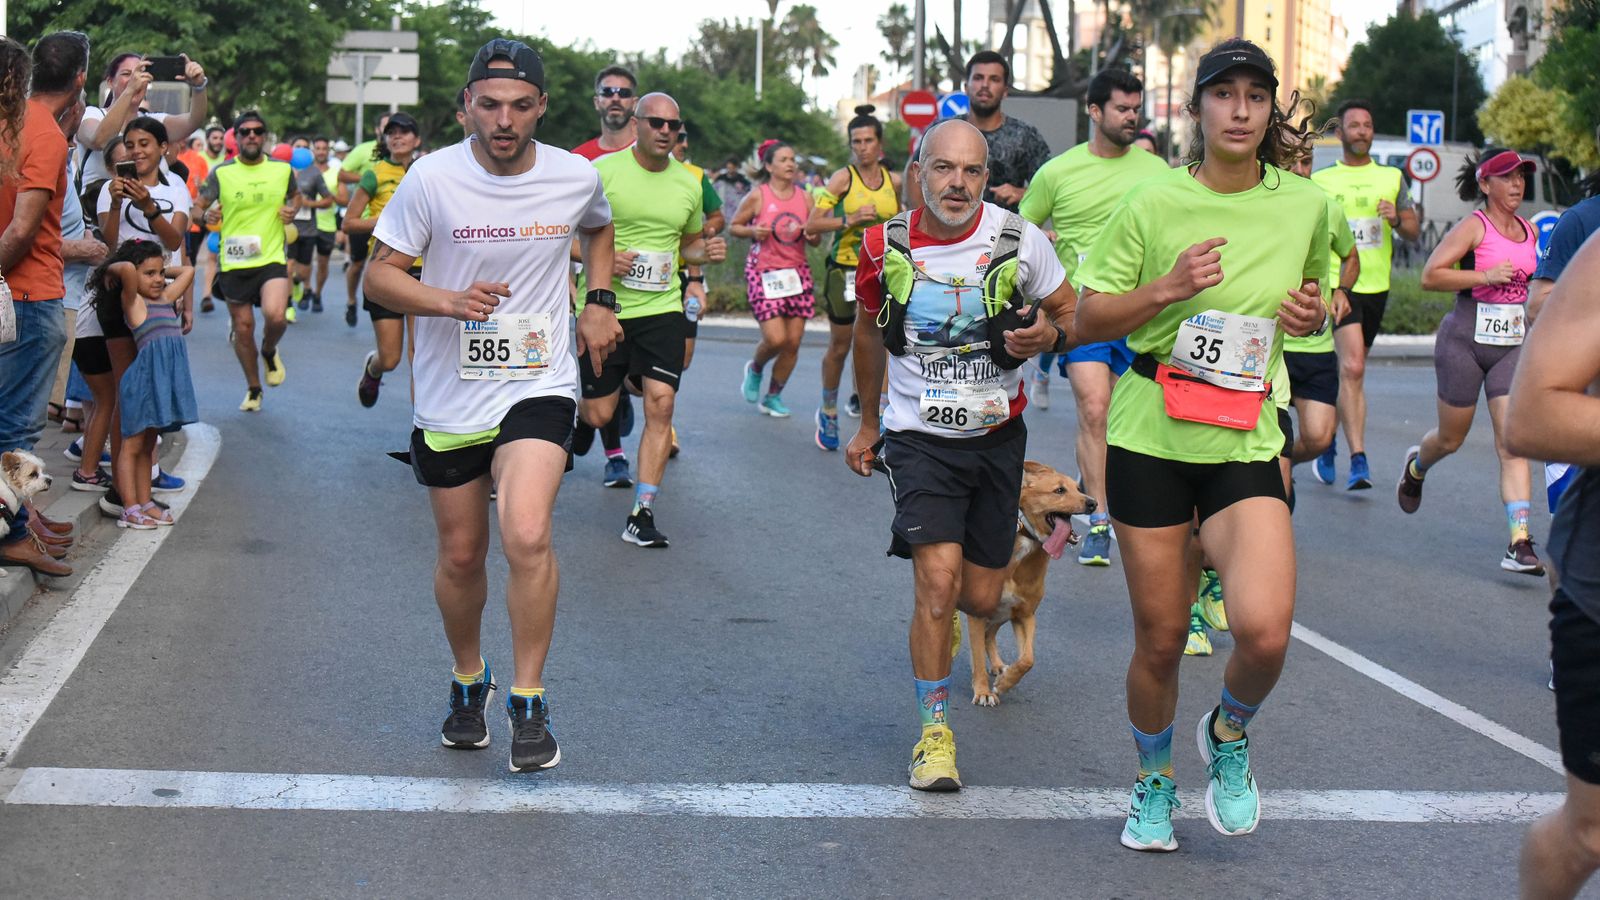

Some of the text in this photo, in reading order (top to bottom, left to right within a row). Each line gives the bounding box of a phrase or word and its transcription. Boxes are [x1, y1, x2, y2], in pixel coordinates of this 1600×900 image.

[1414, 159, 1434, 172] 30
[452, 221, 571, 239] cárnicas urbano
[227, 246, 244, 256] 455
[628, 263, 653, 280] 591
[465, 320, 480, 331] XXI
[1204, 321, 1224, 330] Popular
[1206, 315, 1225, 325] Carrera
[1485, 318, 1509, 334] 764
[468, 338, 510, 362] 585
[1190, 335, 1223, 364] 35
[951, 354, 967, 380] la
[925, 388, 941, 399] XXI
[926, 406, 968, 427] 286
